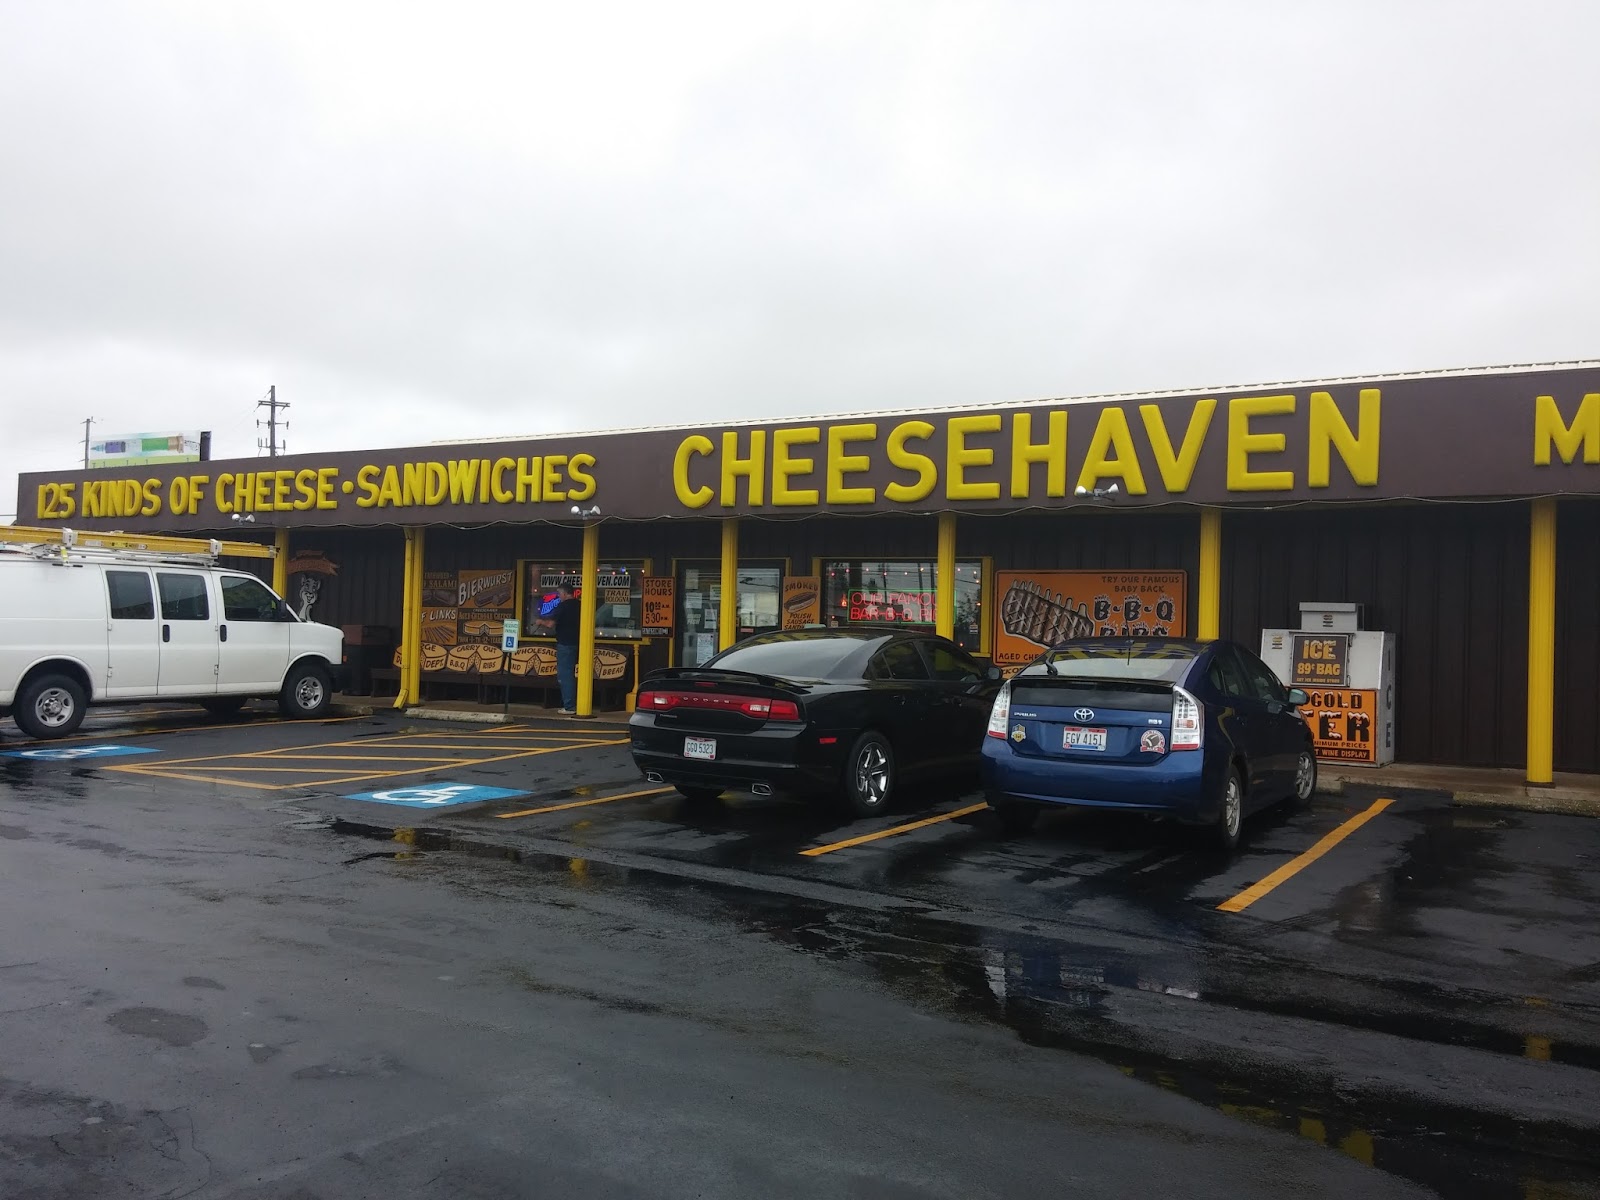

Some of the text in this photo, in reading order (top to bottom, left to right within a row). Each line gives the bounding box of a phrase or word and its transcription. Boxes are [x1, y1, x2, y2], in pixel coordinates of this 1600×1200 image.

[672, 390, 1382, 508] CHEESEHAVEN
[37, 453, 597, 519] 125 KINDS OF CHEESE SANDWICHES
[430, 579, 457, 589] SALAMI
[645, 579, 672, 588] STORE
[1101, 575, 1180, 584] TRY OUR FAMOUS
[458, 571, 513, 607] BIERWURST
[645, 587, 673, 596] HOURS
[784, 582, 819, 592] SMOKED
[1114, 585, 1165, 593] BABY BACK
[606, 589, 629, 597] TRAIL
[851, 591, 883, 605] OUR
[430, 609, 457, 621] LINKS
[457, 644, 498, 654] CARRY OUT
[1303, 639, 1337, 660] ICE
[998, 652, 1021, 661] AGED
[482, 660, 496, 670] RIBS
[511, 662, 521, 672] ND
[1316, 663, 1341, 676] BAG
[602, 666, 625, 676] BREAD
[1065, 732, 1102, 746] EGV 4151
[699, 743, 714, 754] 5323
[1341, 741, 1367, 749] PRICES
[1321, 748, 1339, 757] WINE
[1341, 749, 1368, 759] DISPLAY
